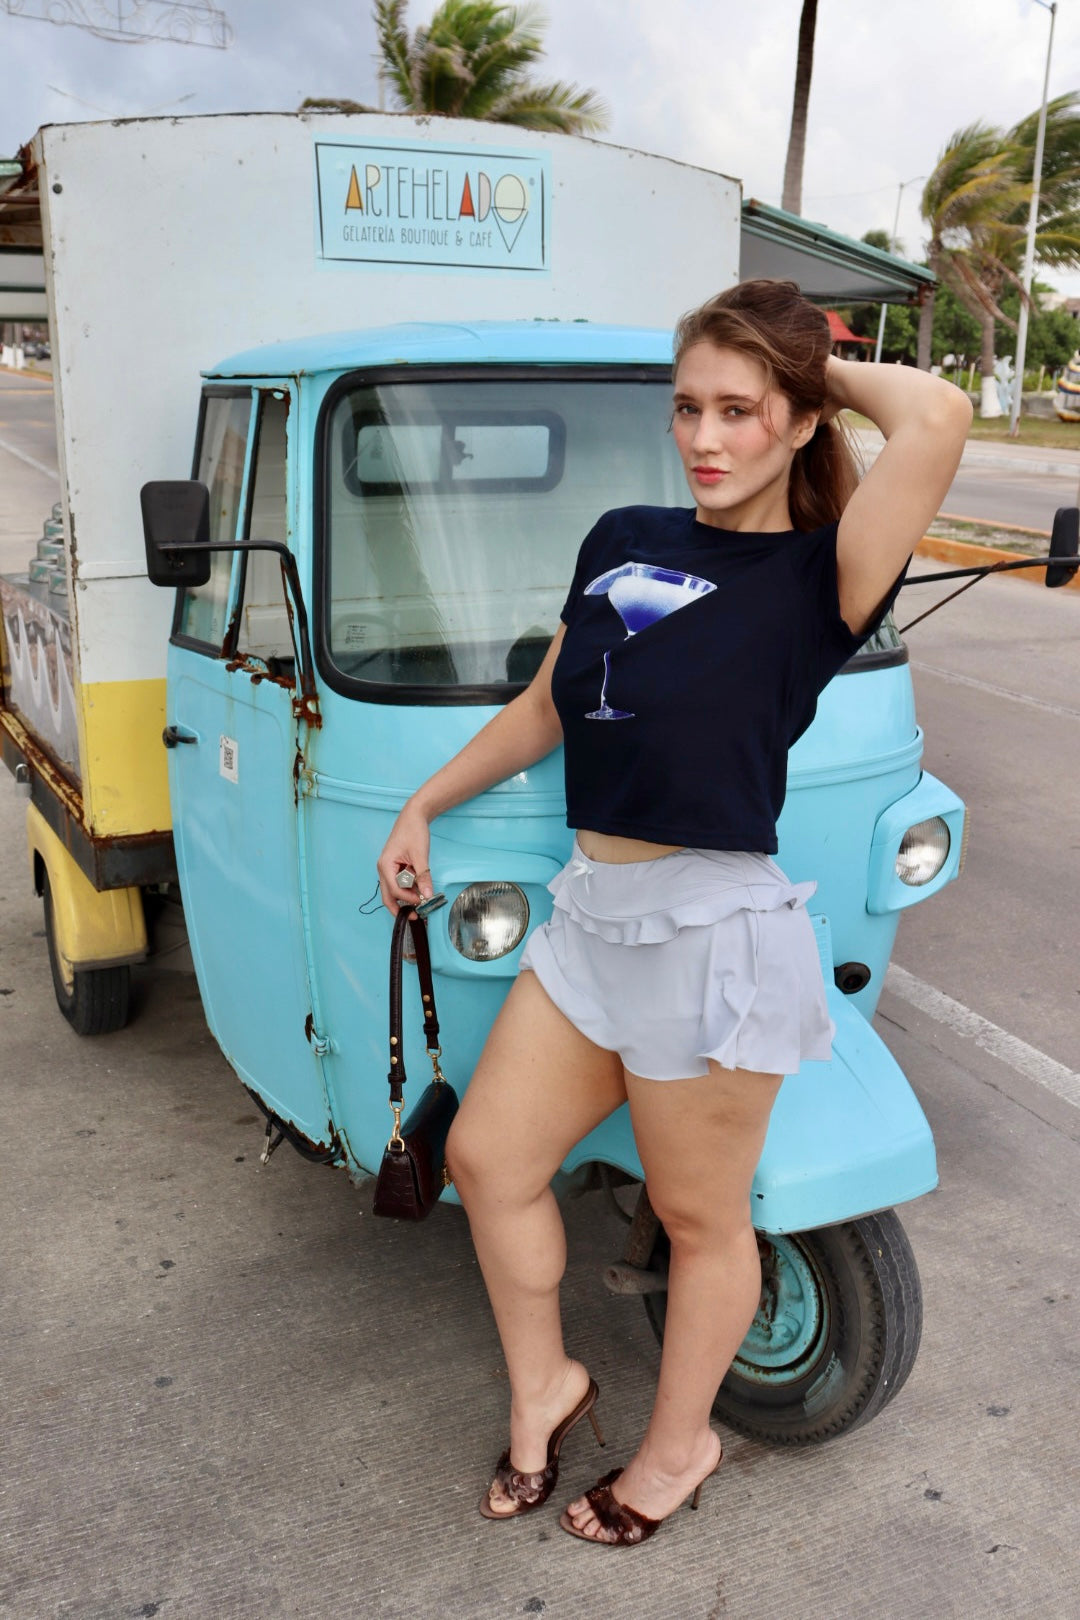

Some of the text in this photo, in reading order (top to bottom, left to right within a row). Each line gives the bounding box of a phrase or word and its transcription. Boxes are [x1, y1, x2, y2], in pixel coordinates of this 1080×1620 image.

[344, 163, 526, 224] ARTEHELADO
[343, 224, 492, 248] GELATERÍA BOUTIQUE & CAFÉ
